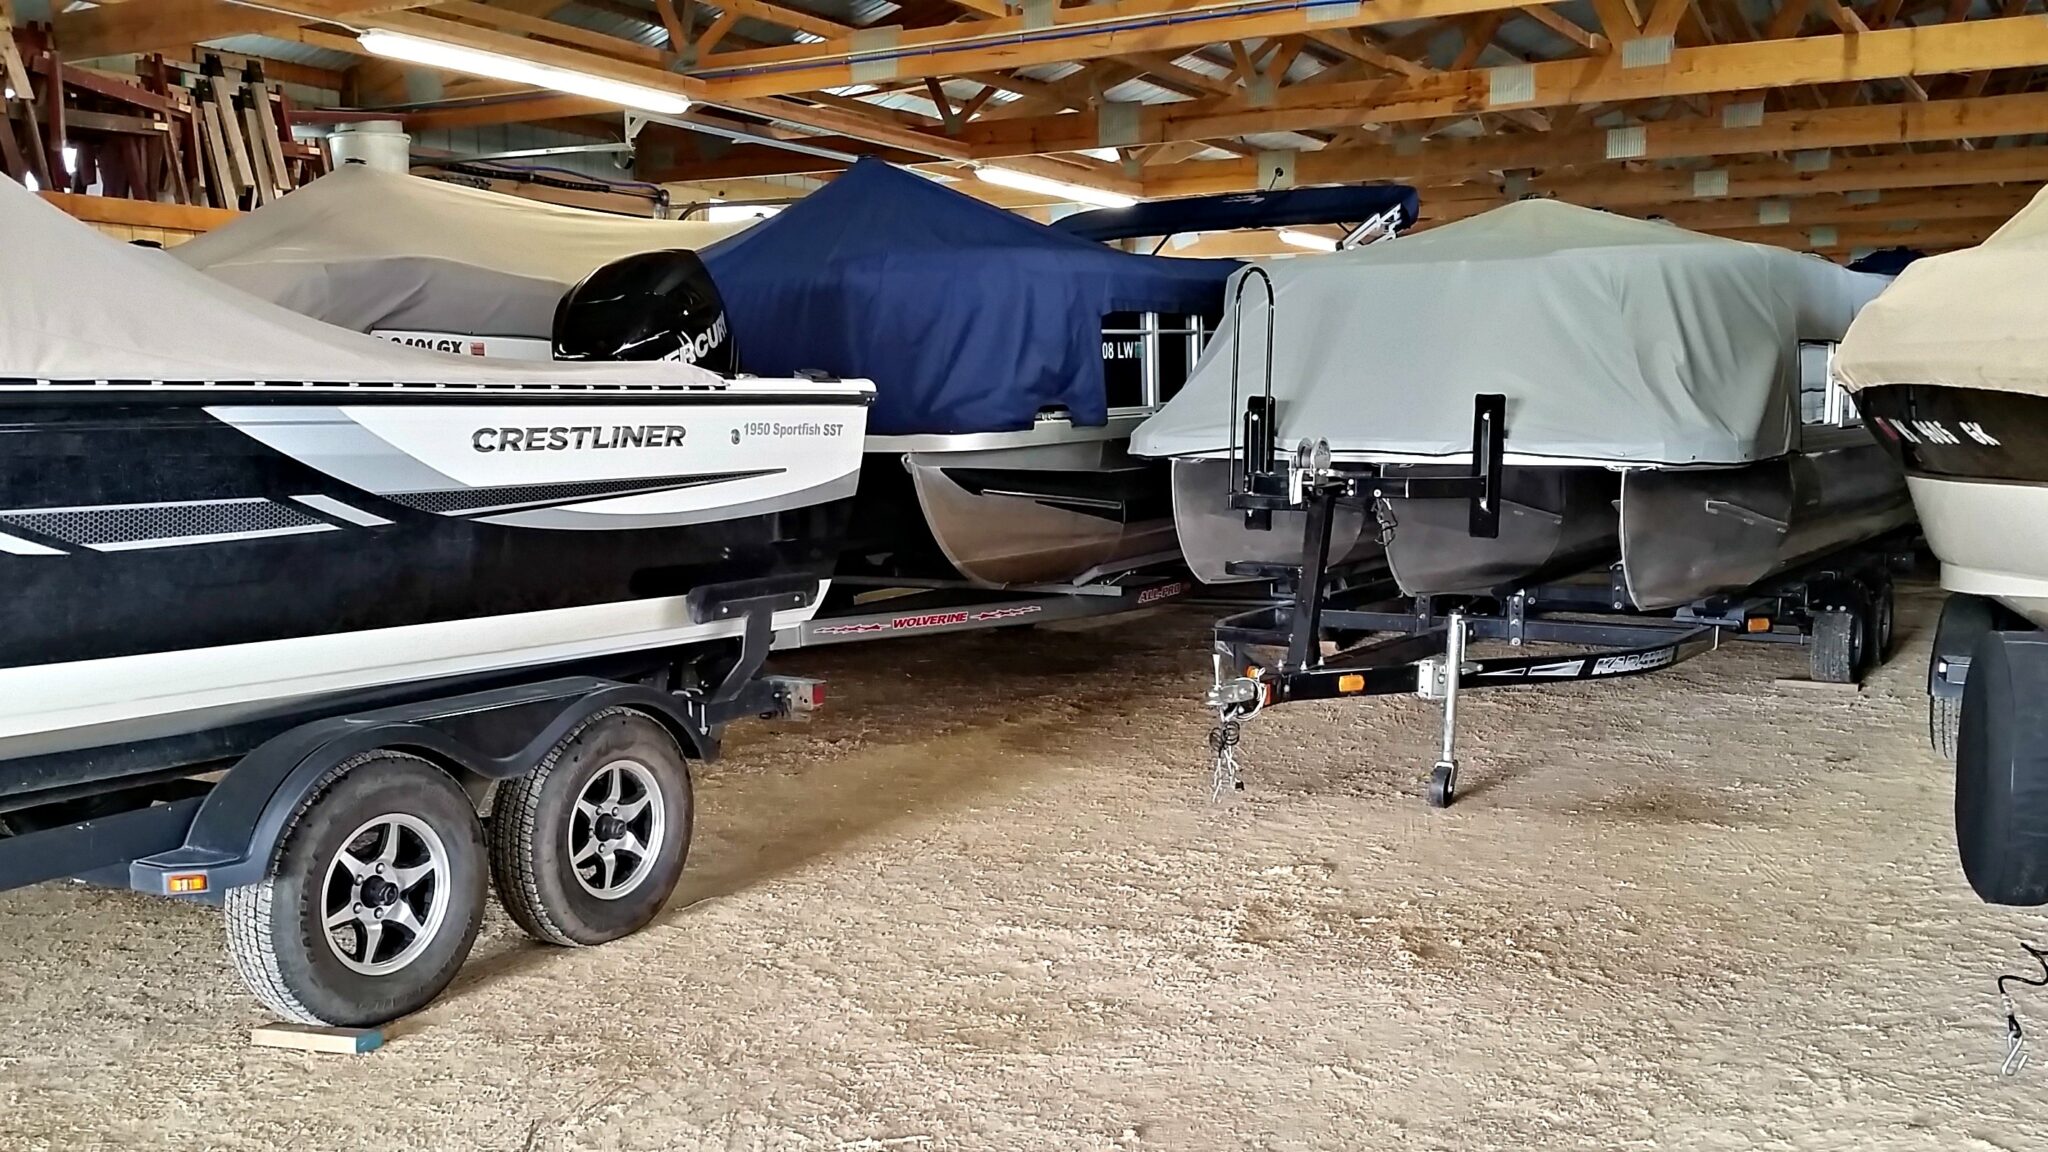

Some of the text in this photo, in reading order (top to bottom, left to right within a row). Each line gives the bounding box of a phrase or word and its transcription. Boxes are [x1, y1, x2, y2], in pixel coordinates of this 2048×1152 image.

[658, 310, 728, 364] ERCUR
[471, 425, 686, 452] CRESTLINER
[744, 422, 843, 438] 1950 Sportfish SST
[1137, 582, 1181, 604] ALL-PRO
[892, 611, 969, 630] WOLVERINE
